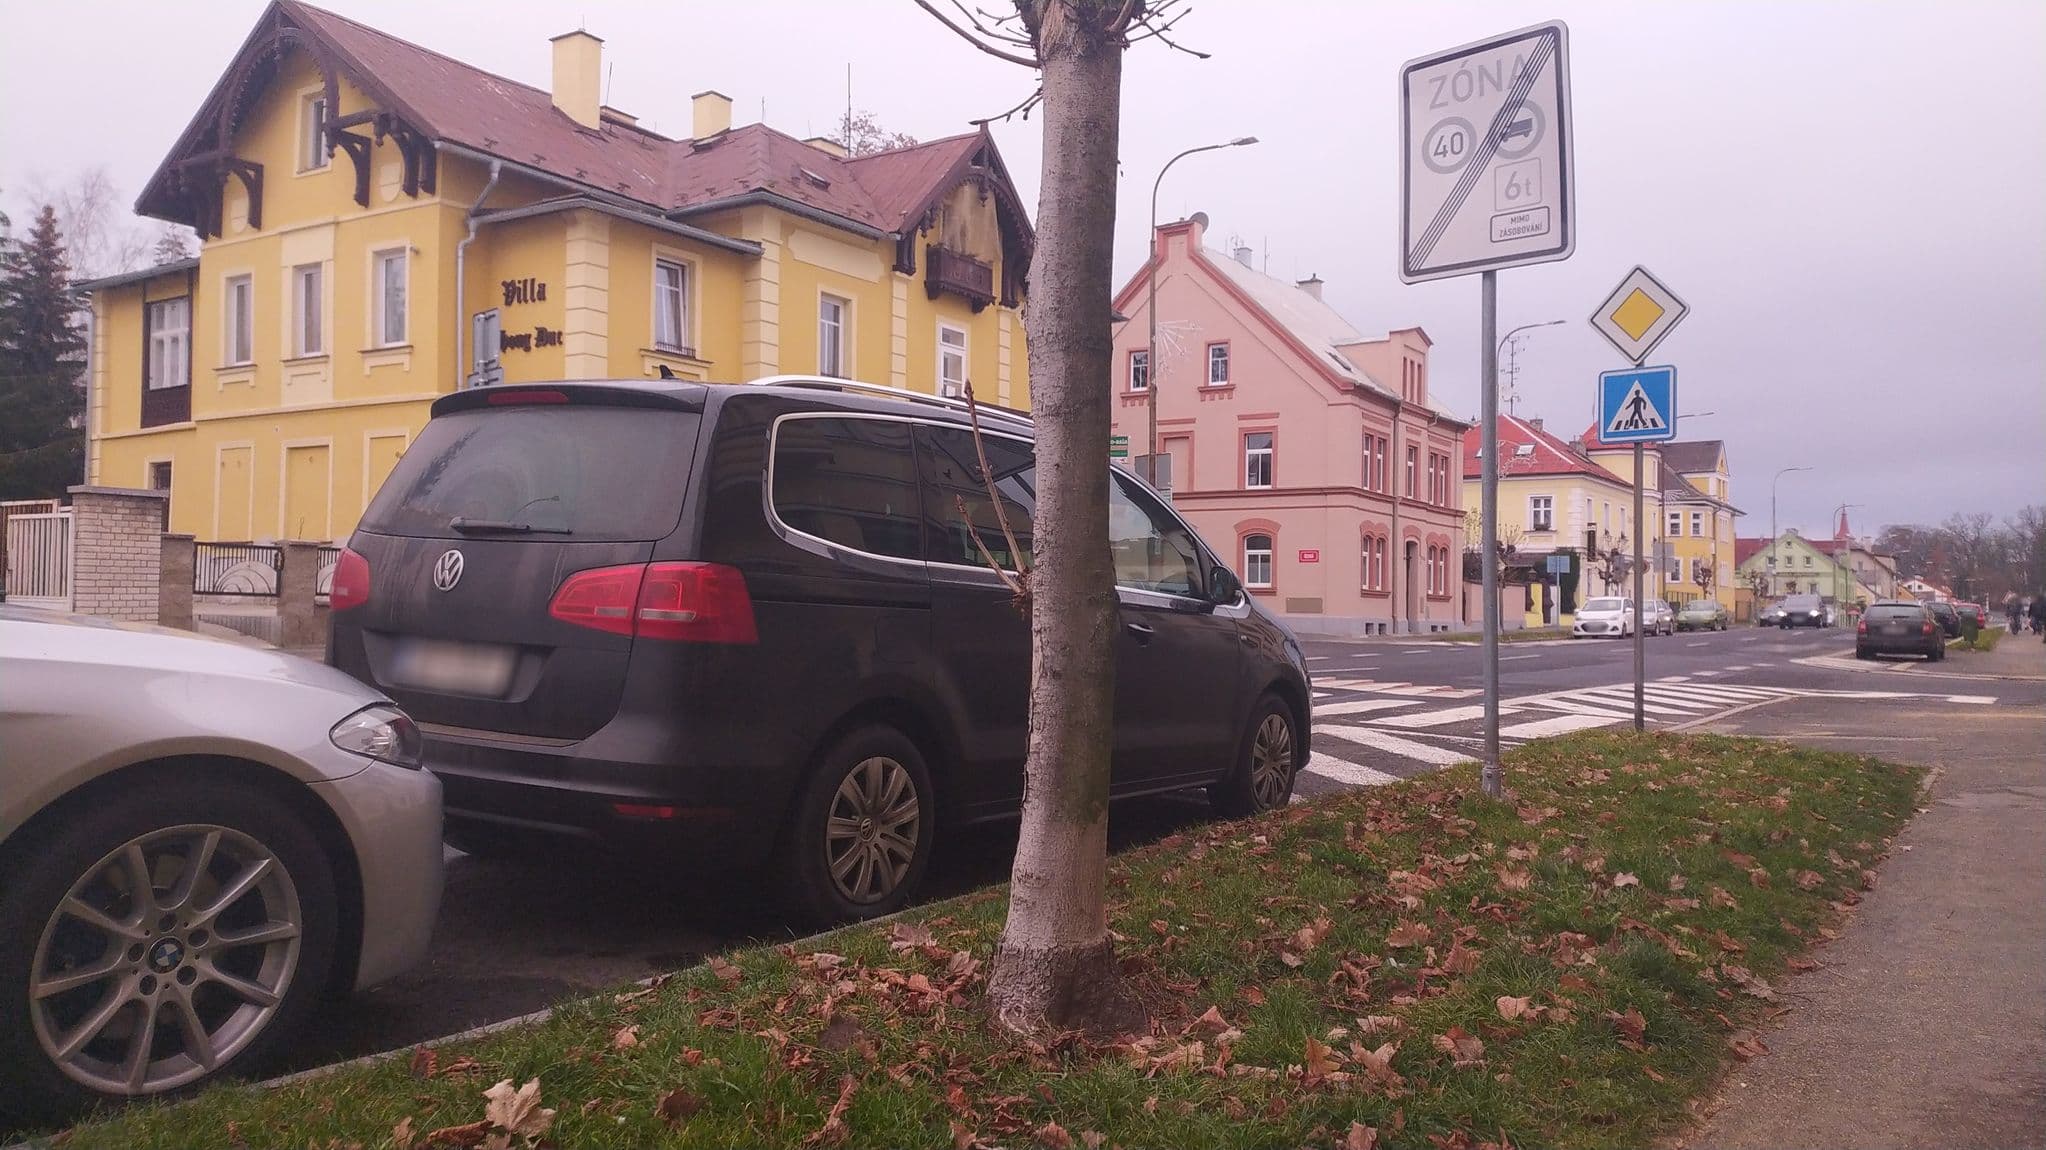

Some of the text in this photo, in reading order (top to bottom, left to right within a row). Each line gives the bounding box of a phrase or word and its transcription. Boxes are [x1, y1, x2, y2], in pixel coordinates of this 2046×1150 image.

[1428, 53, 1533, 111] ZÓNA
[1434, 131, 1464, 158] 40
[1511, 214, 1530, 225] MIMO
[501, 277, 547, 307] Villa
